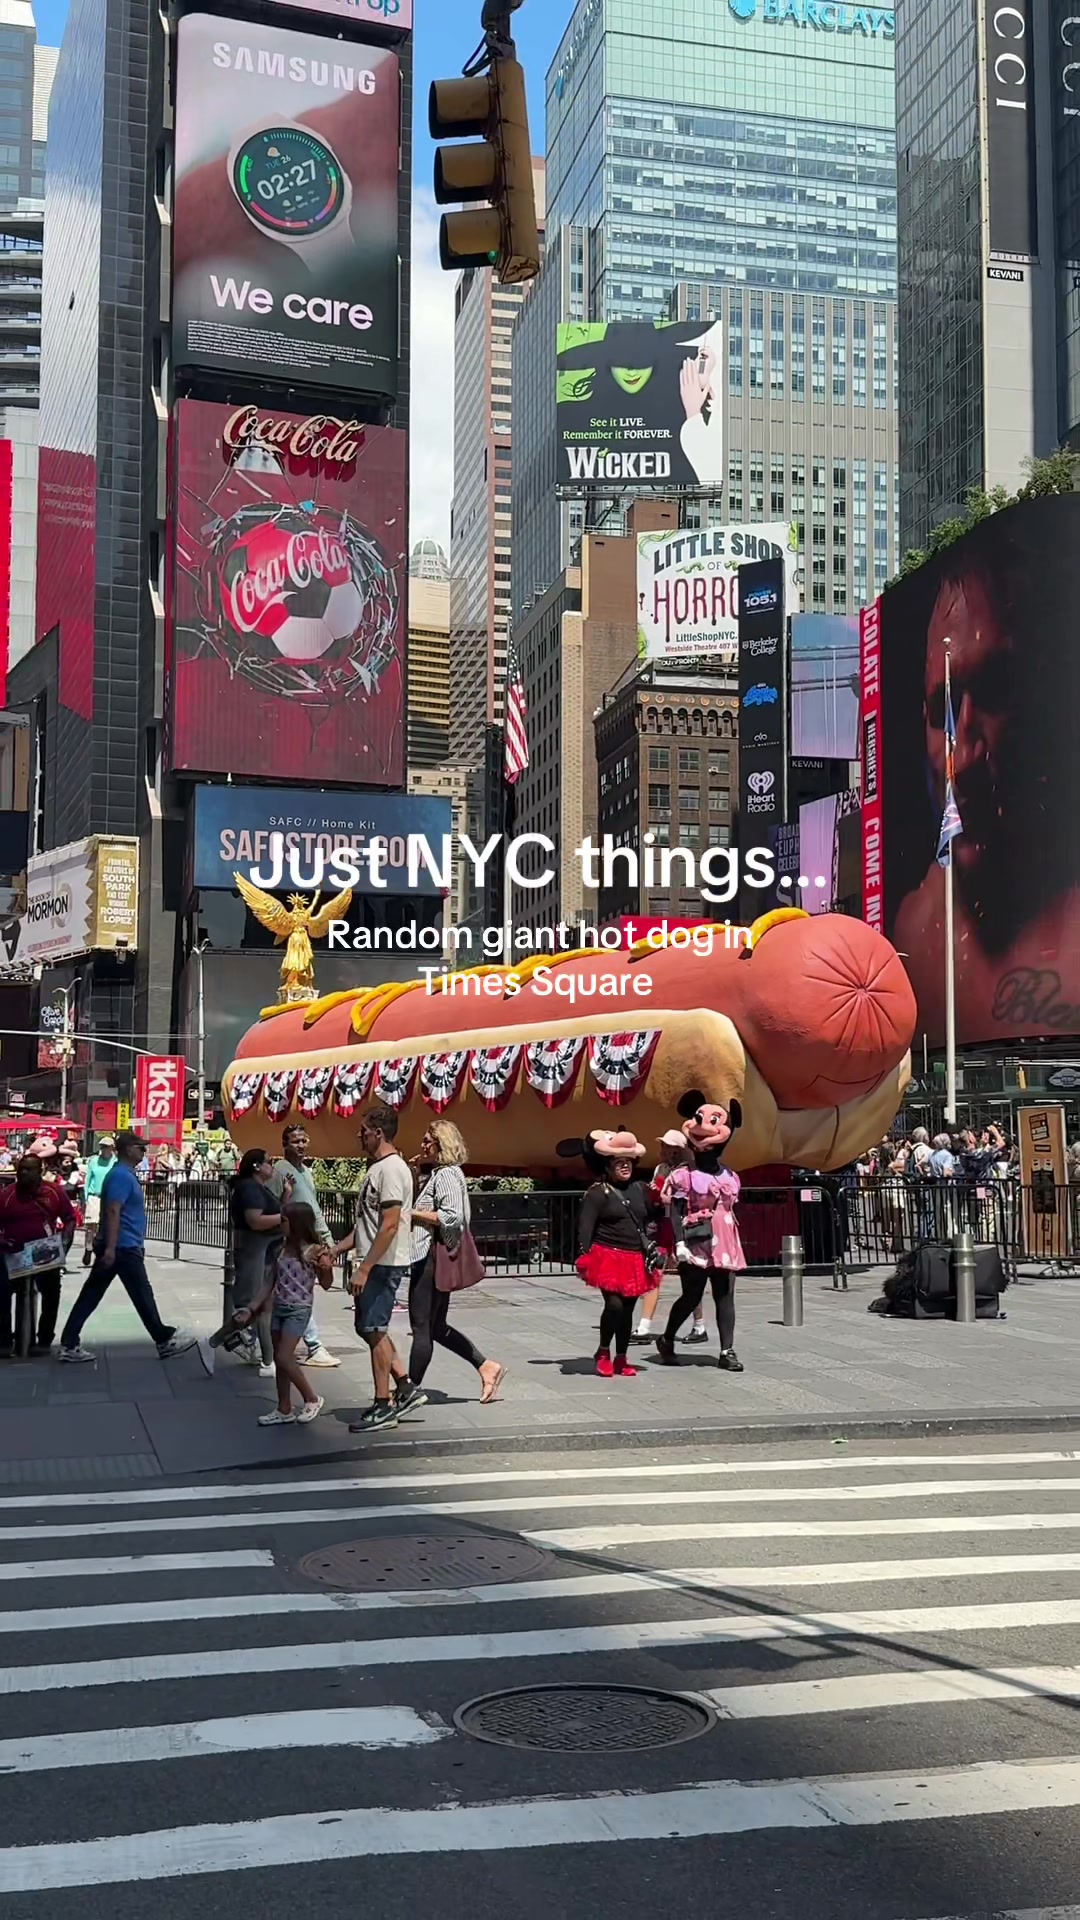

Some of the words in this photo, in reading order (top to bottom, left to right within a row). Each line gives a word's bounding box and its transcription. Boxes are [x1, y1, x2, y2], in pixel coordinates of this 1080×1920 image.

[763, 0, 895, 32] BARCLAYS
[212, 42, 376, 95] SAMSUNG
[257, 158, 316, 199] 02:27
[989, 268, 1021, 280] KEVANI
[210, 275, 274, 314] We
[283, 293, 374, 330] care
[590, 418, 608, 427] See
[609, 418, 618, 427] it
[620, 418, 646, 427] LIVE.
[563, 430, 613, 440] Remember
[615, 430, 623, 440] it
[624, 429, 673, 440] FOREVER.
[654, 531, 725, 575] LITTLE
[707, 561, 722, 571] OF
[744, 593, 778, 608] 105.1
[665, 644, 693, 652] Westside
[694, 643, 717, 651] Theatre
[749, 636, 779, 649] Berkeley
[750, 644, 777, 656] College
[792, 760, 823, 769] KEVANI
[747, 793, 775, 804] iHeart
[747, 802, 775, 813] Radio
[269, 816, 302, 827] SAFC
[321, 818, 354, 830] Home
[359, 820, 376, 830] Kit
[864, 816, 880, 890] COME
[102, 873, 135, 883] SOUTH
[105, 882, 132, 892] PARK
[28, 894, 69, 924] MORMON
[100, 906, 135, 917] ROBERT
[103, 915, 132, 925] LOPEZ
[146, 1060, 178, 1118] tkts
